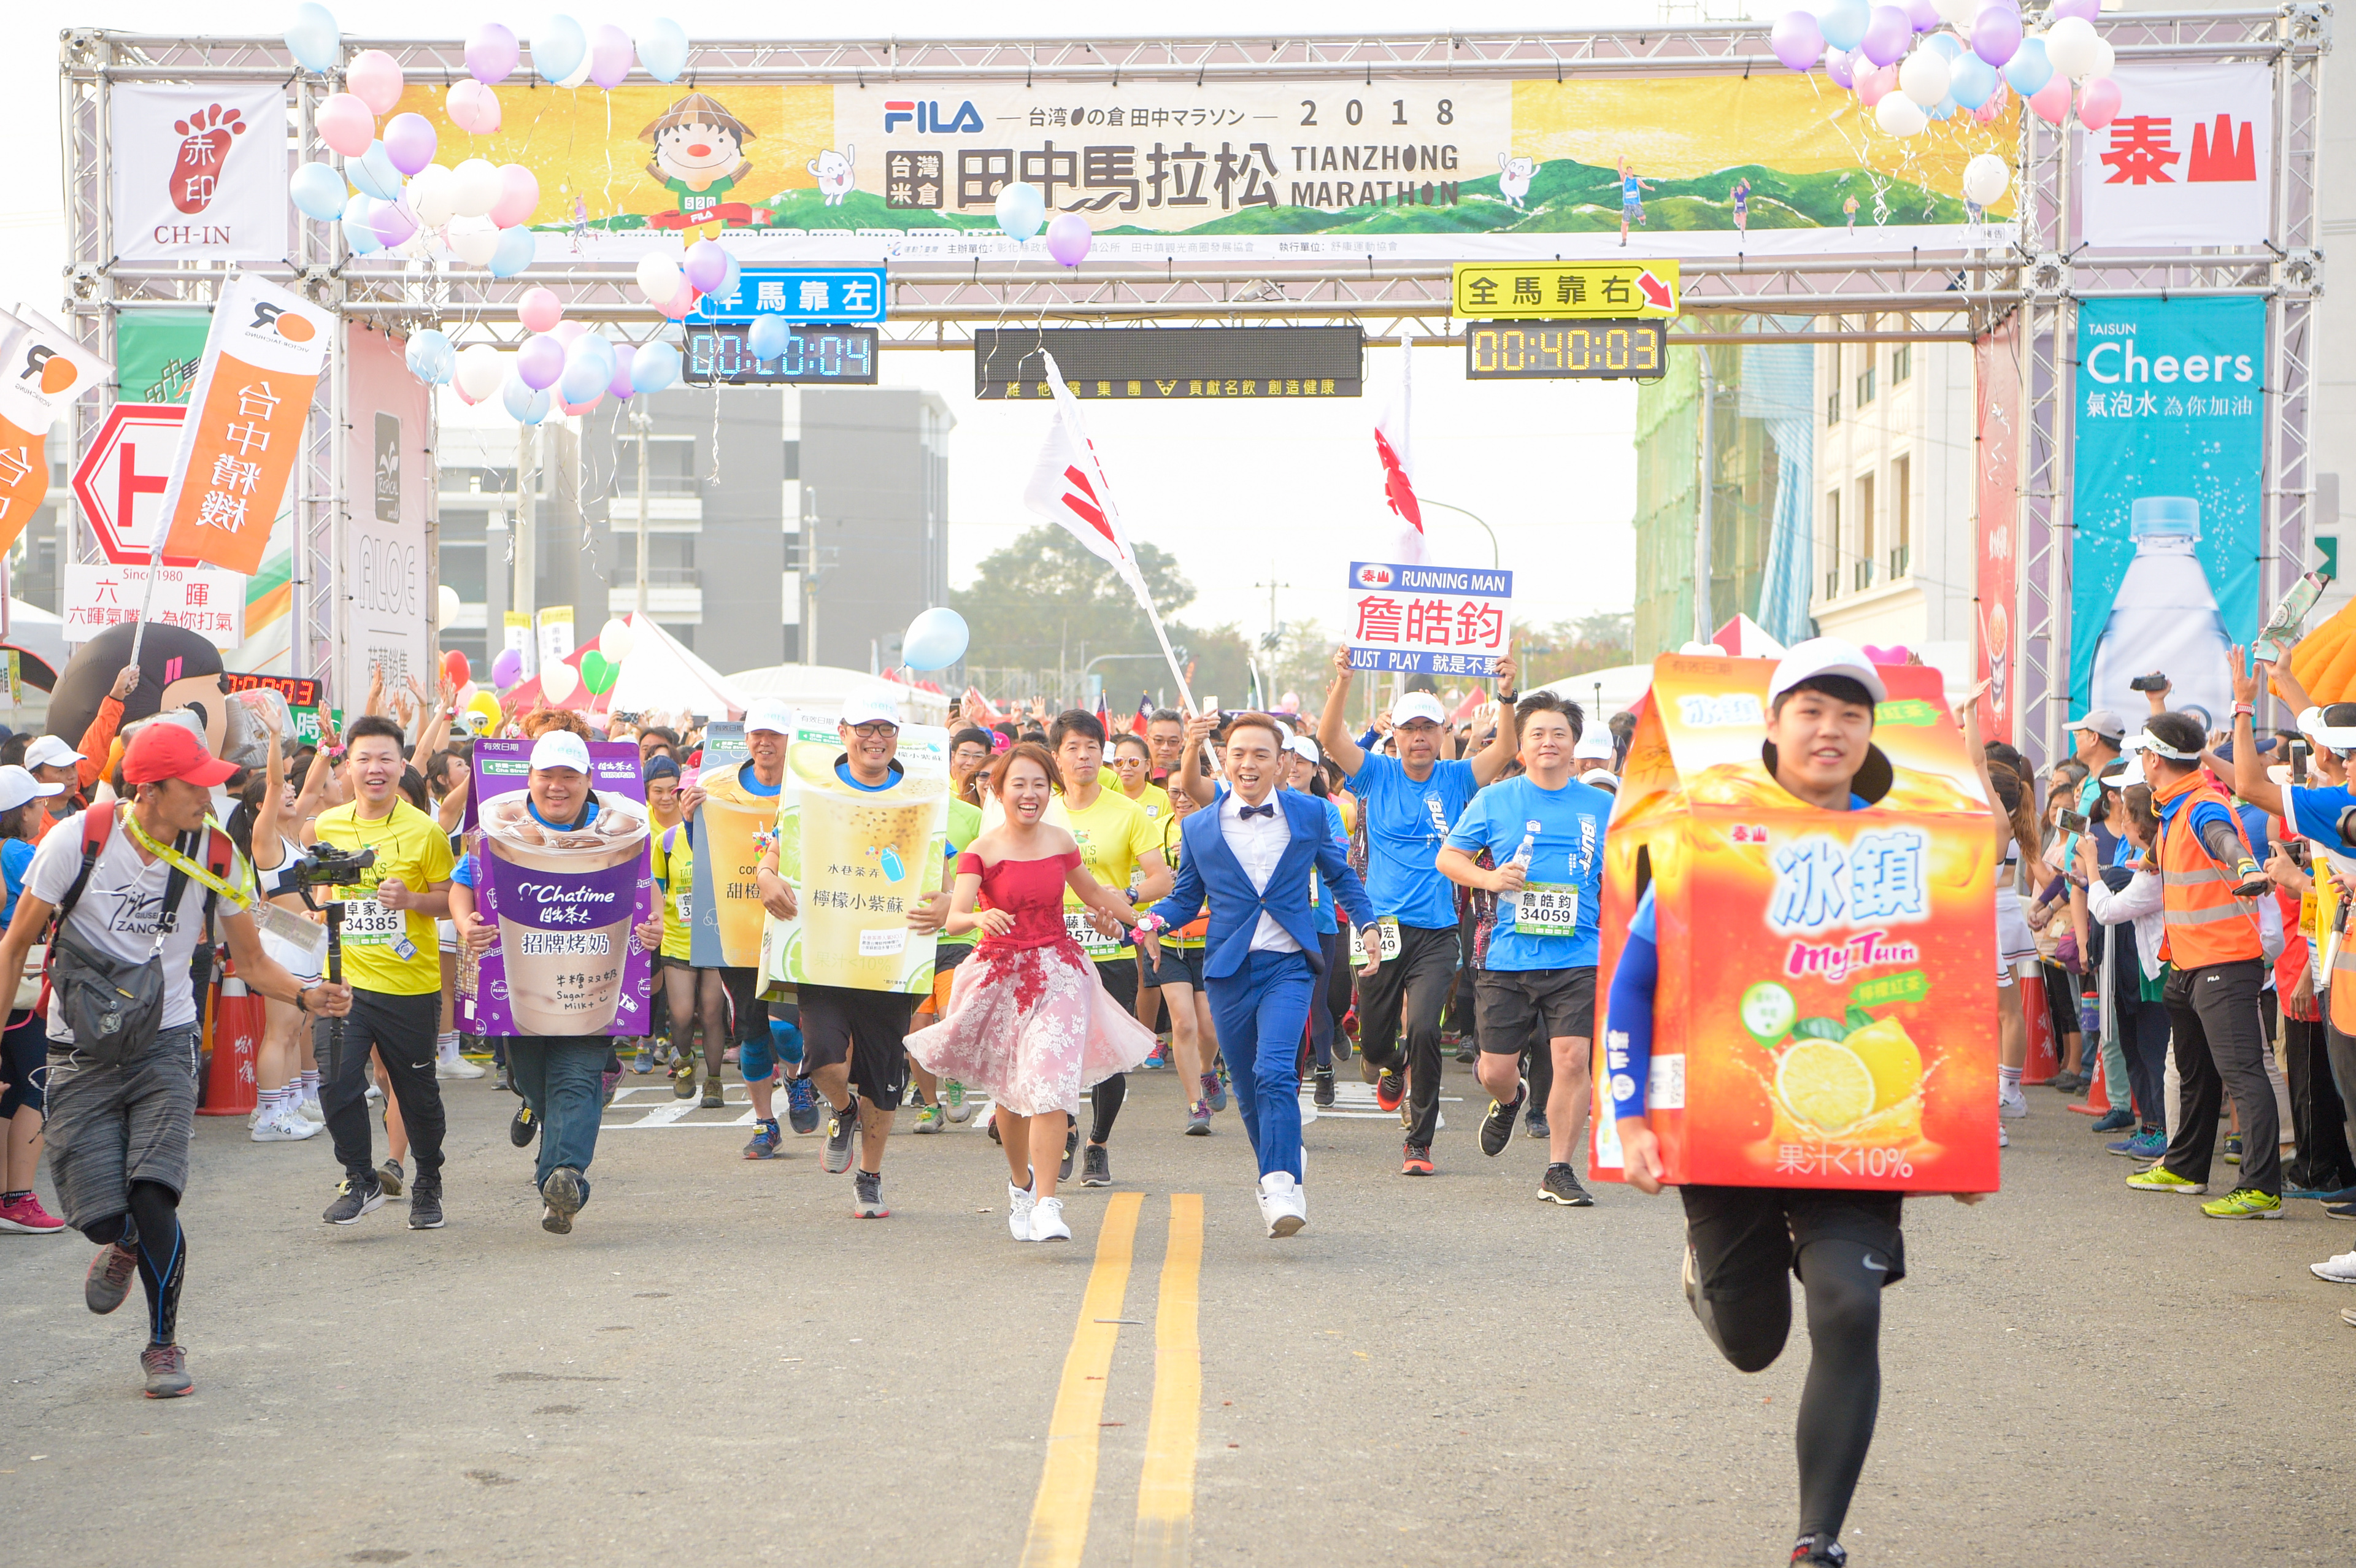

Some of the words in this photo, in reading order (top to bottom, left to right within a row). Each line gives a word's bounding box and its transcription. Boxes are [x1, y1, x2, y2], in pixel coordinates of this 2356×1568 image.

[884, 101, 984, 134] FILA
[1130, 106, 1245, 128] 田中マラソン
[1291, 144, 1458, 173] TIANZHONG
[2100, 113, 2257, 185] 泰山
[185, 134, 215, 207] 赤印
[891, 153, 939, 179] 台灣
[957, 140, 1281, 214] 田中馬拉松
[890, 182, 939, 207] 米倉
[1291, 180, 1459, 207] MARATHON
[690, 210, 714, 223] FILA
[154, 226, 231, 244] CH-IN
[1983, 229, 2004, 240] 廣告
[1331, 241, 1398, 252] 舒康運動協會
[1469, 275, 1631, 306] 全馬靠右
[2088, 323, 2136, 336] TAISUN
[1475, 328, 1656, 371] 00:40:03
[2086, 339, 2253, 384] Cheers
[1189, 380, 1256, 396] 貢獻名飲
[1268, 379, 1336, 395] 創造健康
[2086, 391, 2158, 418] 氣泡水
[2163, 395, 2253, 417] 為你加油
[156, 569, 183, 582] 1980
[360, 534, 415, 616] ALOE
[1361, 570, 1390, 583] 泰山
[1401, 570, 1468, 590] RUNNING
[1471, 574, 1506, 592] MAN
[1355, 595, 1503, 648] 詹皓鈞
[1350, 650, 1381, 668] JUST
[1388, 652, 1422, 671] PLAY
[1433, 653, 1499, 675] 就是不累
[800, 715, 834, 726] 有效日期
[483, 742, 519, 751] 有效日期
[1732, 826, 1768, 844] 泰山
[1577, 820, 1596, 877] BUFF
[827, 863, 880, 879] 水巷茶弄
[1773, 832, 1922, 926] 冰鎮
[537, 885, 615, 904] Chatime
[726, 882, 761, 899] 甜橙
[812, 889, 904, 914] 檸檬小紫蘇
[1523, 893, 1571, 909] 詹皓鈞
[345, 917, 398, 931] 34385
[1520, 907, 1571, 923] 34059
[522, 932, 610, 955] 招牌烤奶
